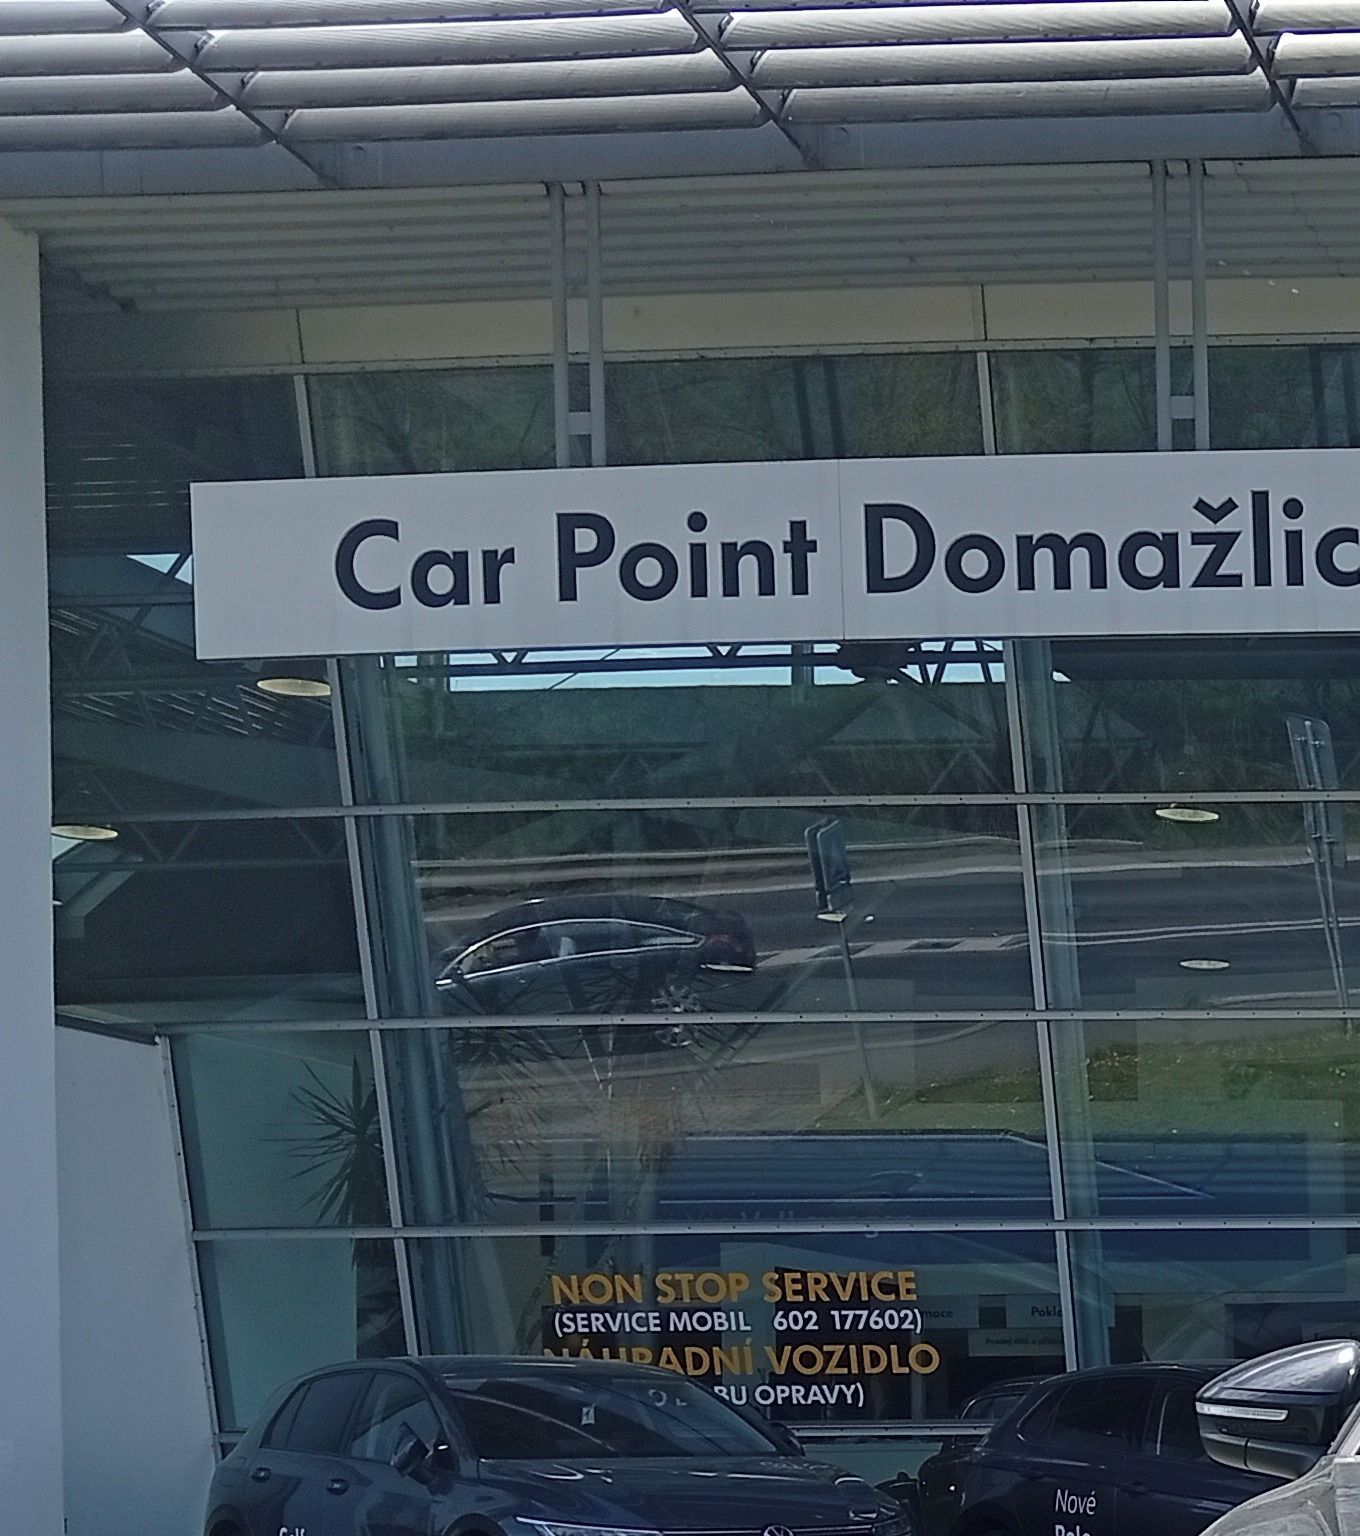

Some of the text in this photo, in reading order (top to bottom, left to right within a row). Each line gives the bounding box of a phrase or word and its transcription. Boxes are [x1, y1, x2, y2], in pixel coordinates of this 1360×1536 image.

[334, 518, 515, 610] Car
[555, 511, 818, 602] Point
[551, 1270, 918, 1304] NON STOP SERVICE
[554, 1311, 662, 1338] (SERVICE
[669, 1310, 752, 1332] MOBIL
[773, 1310, 819, 1331] 602
[830, 1308, 923, 1334] 177602)
[763, 1343, 940, 1375] VOZIDLO
[754, 1382, 865, 1408] OPRAVY)
[1054, 1488, 1097, 1515] Nové
